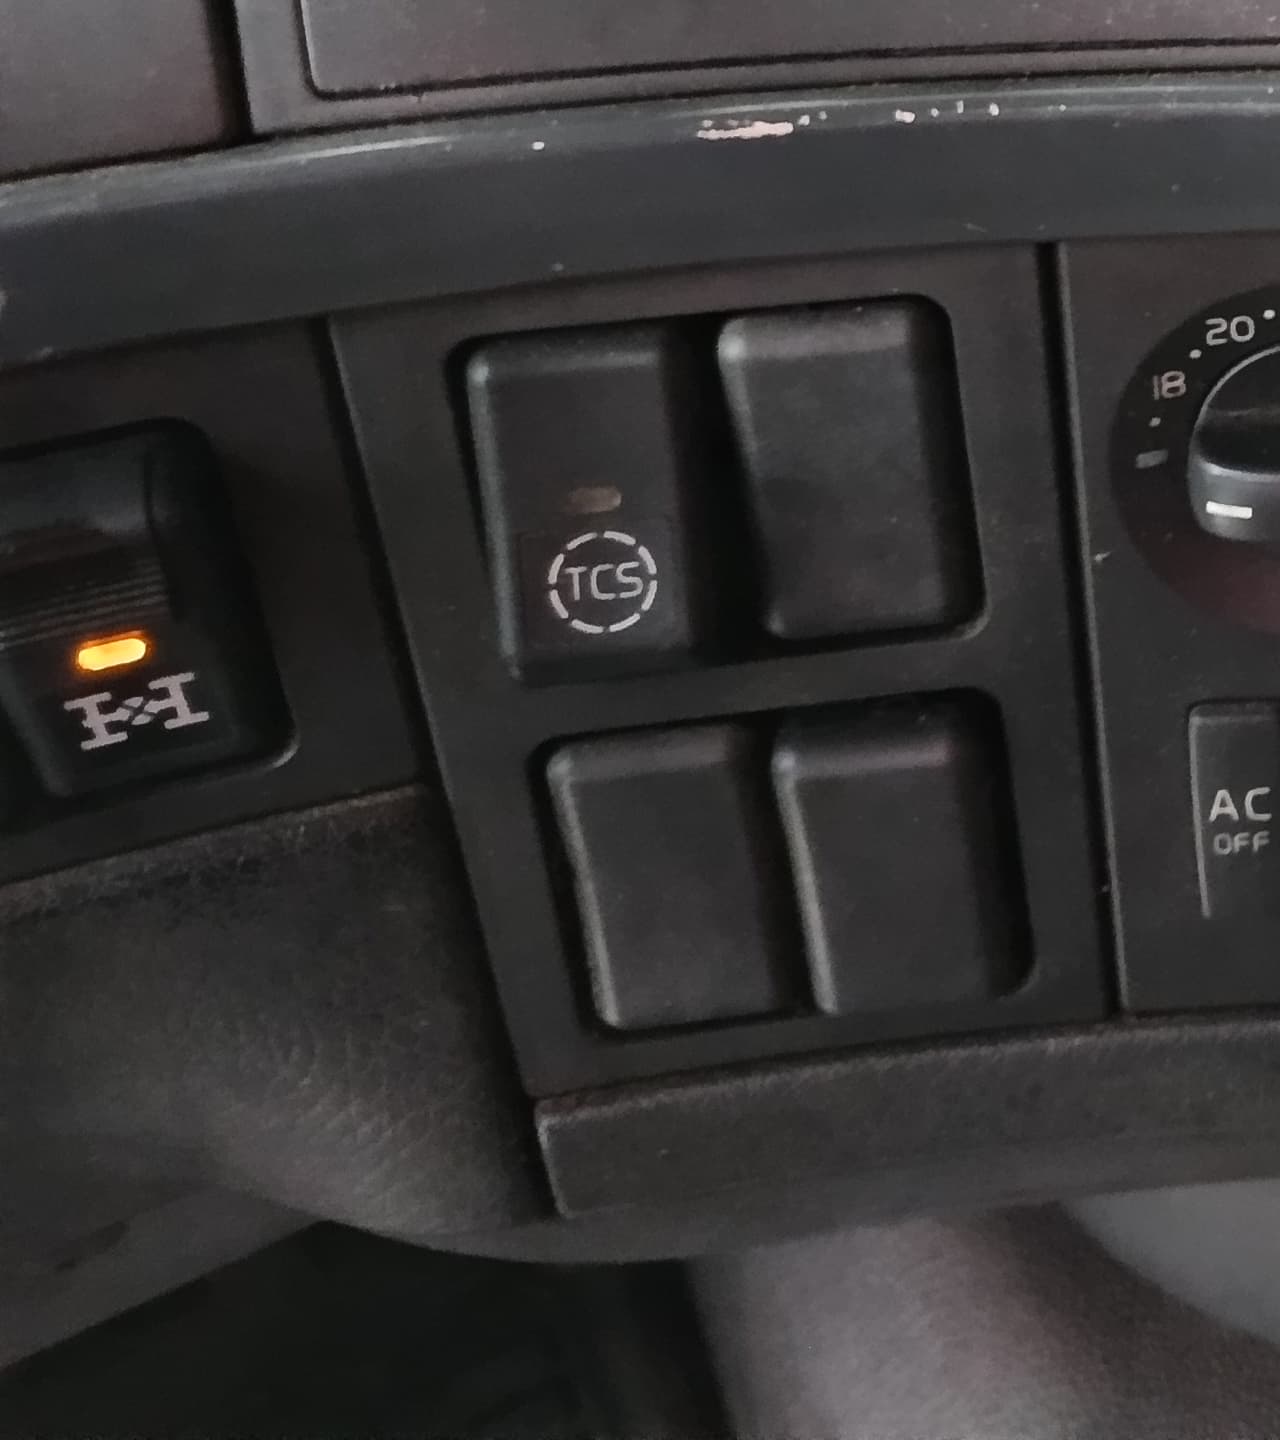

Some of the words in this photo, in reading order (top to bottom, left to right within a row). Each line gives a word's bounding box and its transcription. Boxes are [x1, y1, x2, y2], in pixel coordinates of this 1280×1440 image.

[1153, 370, 1187, 400] 18
[1205, 315, 1255, 346] 20
[564, 561, 644, 601] TCS
[1213, 831, 1271, 855] OFF
